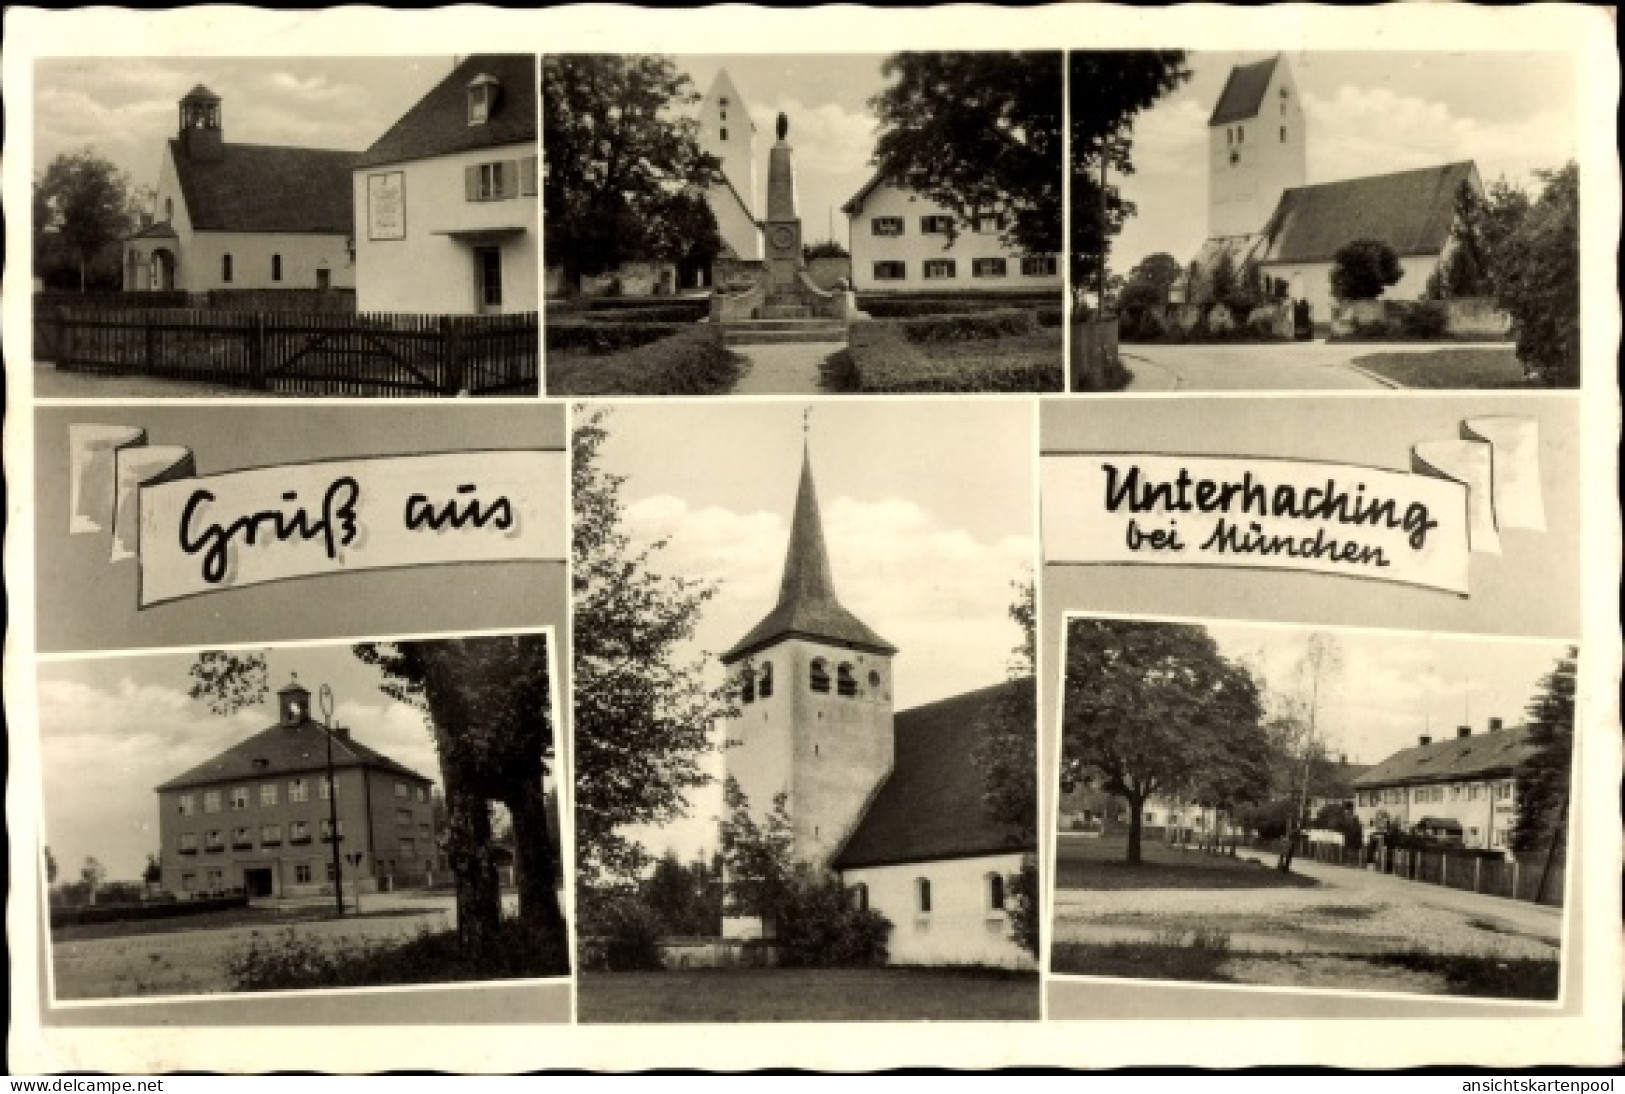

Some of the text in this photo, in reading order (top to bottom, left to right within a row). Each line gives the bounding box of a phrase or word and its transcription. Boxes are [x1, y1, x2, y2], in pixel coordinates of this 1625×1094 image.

[180, 475, 513, 583] Gruß aus
[1101, 462, 1438, 550] Unterhaching
[1125, 518, 1391, 567] bei München
